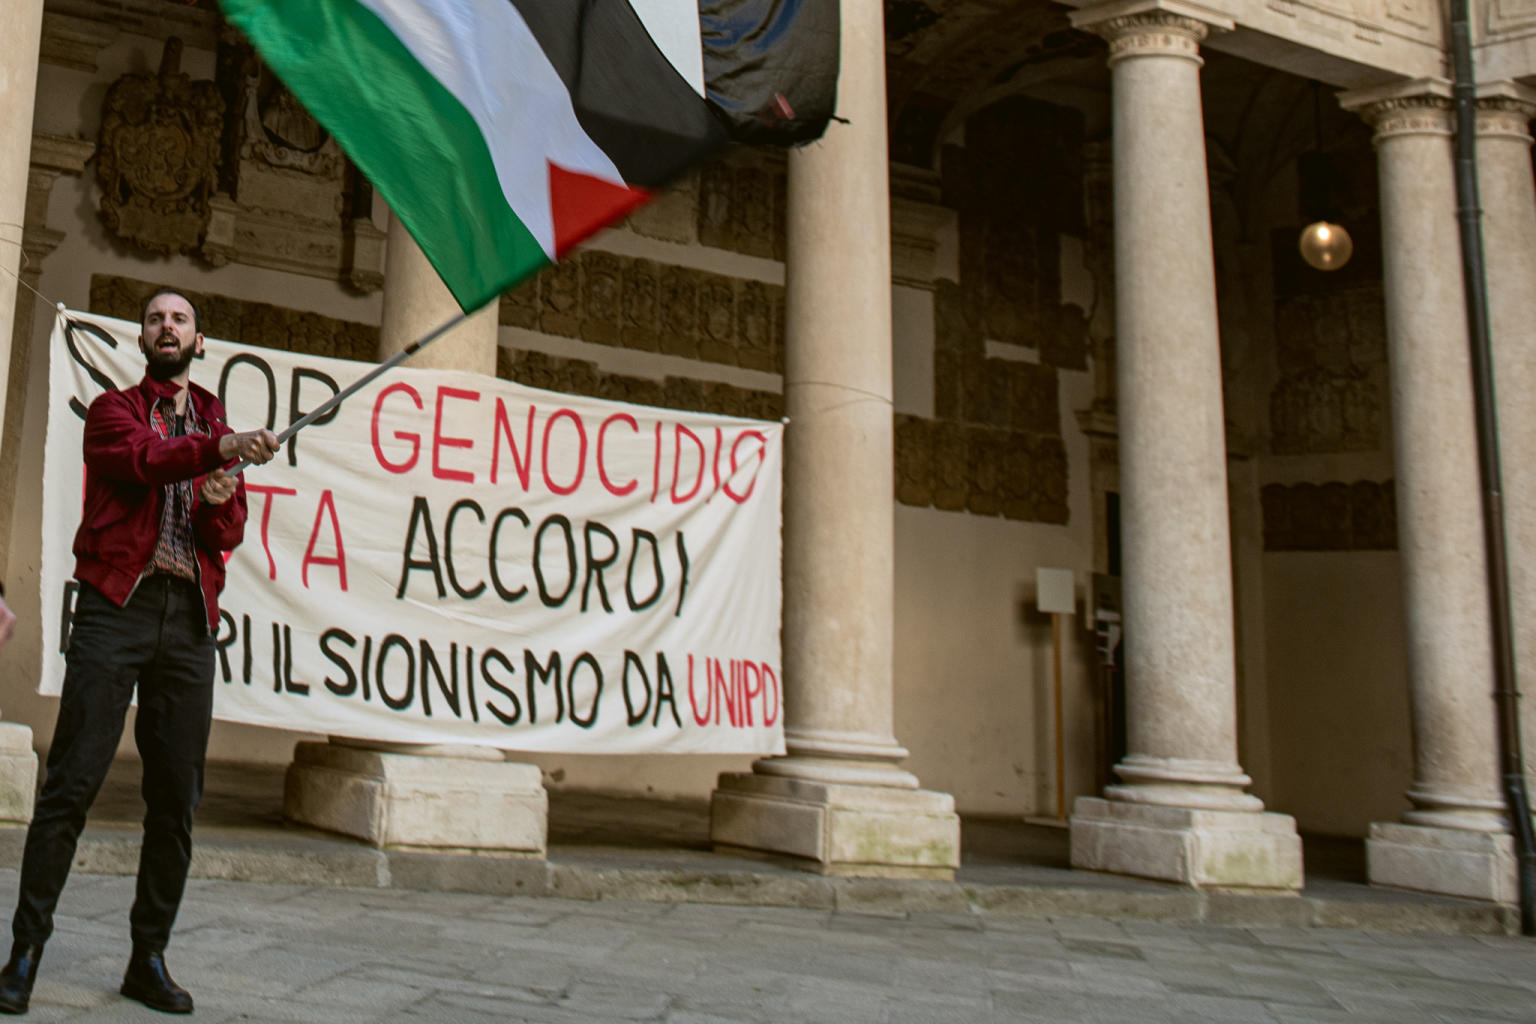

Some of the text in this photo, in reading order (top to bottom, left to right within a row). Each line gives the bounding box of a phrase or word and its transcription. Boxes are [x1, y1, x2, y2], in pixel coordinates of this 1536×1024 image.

[64, 319, 341, 467] SOP
[370, 381, 765, 504] GENOCIDIO
[396, 496, 690, 617] ACCORDI
[272, 623, 310, 696] IL
[320, 627, 604, 728] SIONISMO
[623, 649, 682, 728] DA
[687, 654, 778, 728] UNIPD
